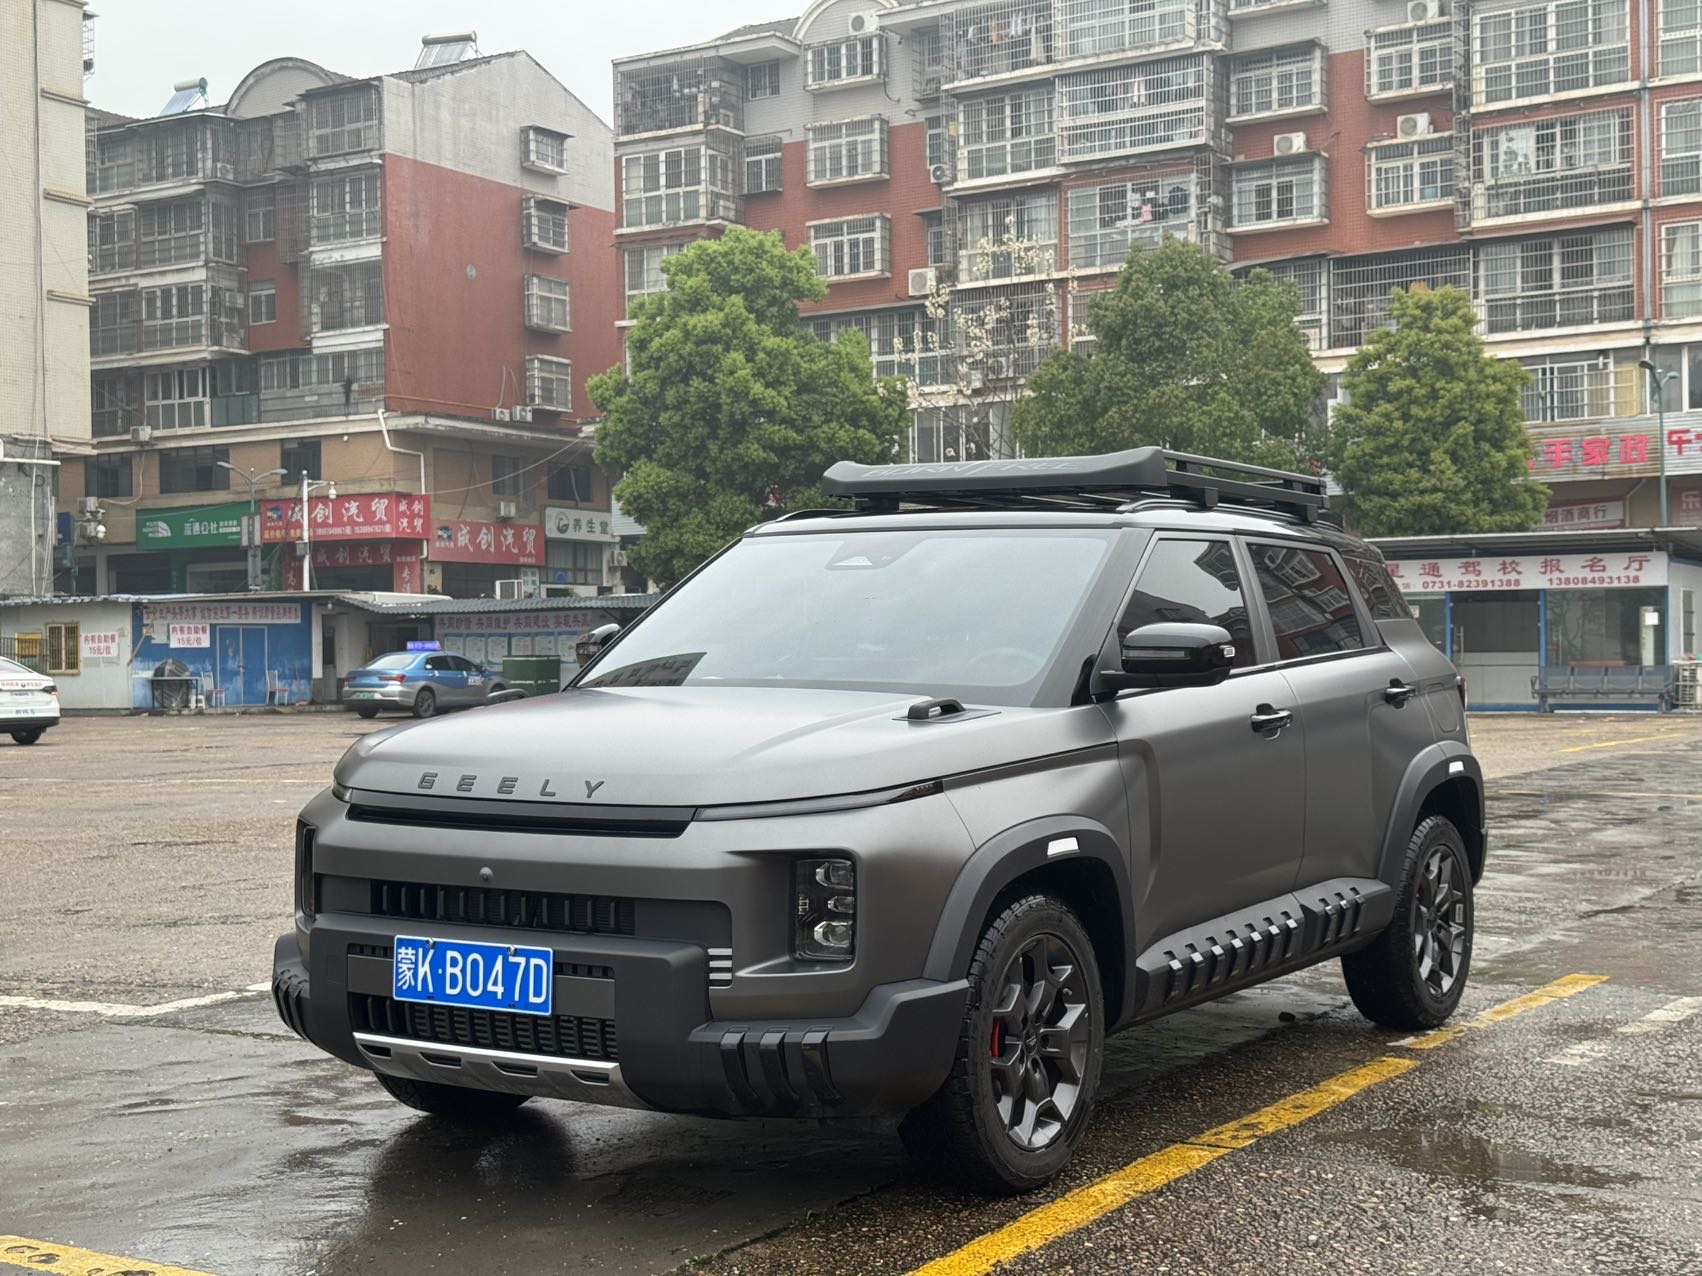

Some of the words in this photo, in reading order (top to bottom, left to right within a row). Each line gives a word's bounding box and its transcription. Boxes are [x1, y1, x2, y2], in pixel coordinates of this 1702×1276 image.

[1527, 433, 1649, 469] 手家政
[1667, 428, 1702, 456] 乐
[1422, 578, 1520, 590] 0731-82391388
[1548, 575, 1640, 586] 13808493138
[417, 771, 606, 798] GEELY
